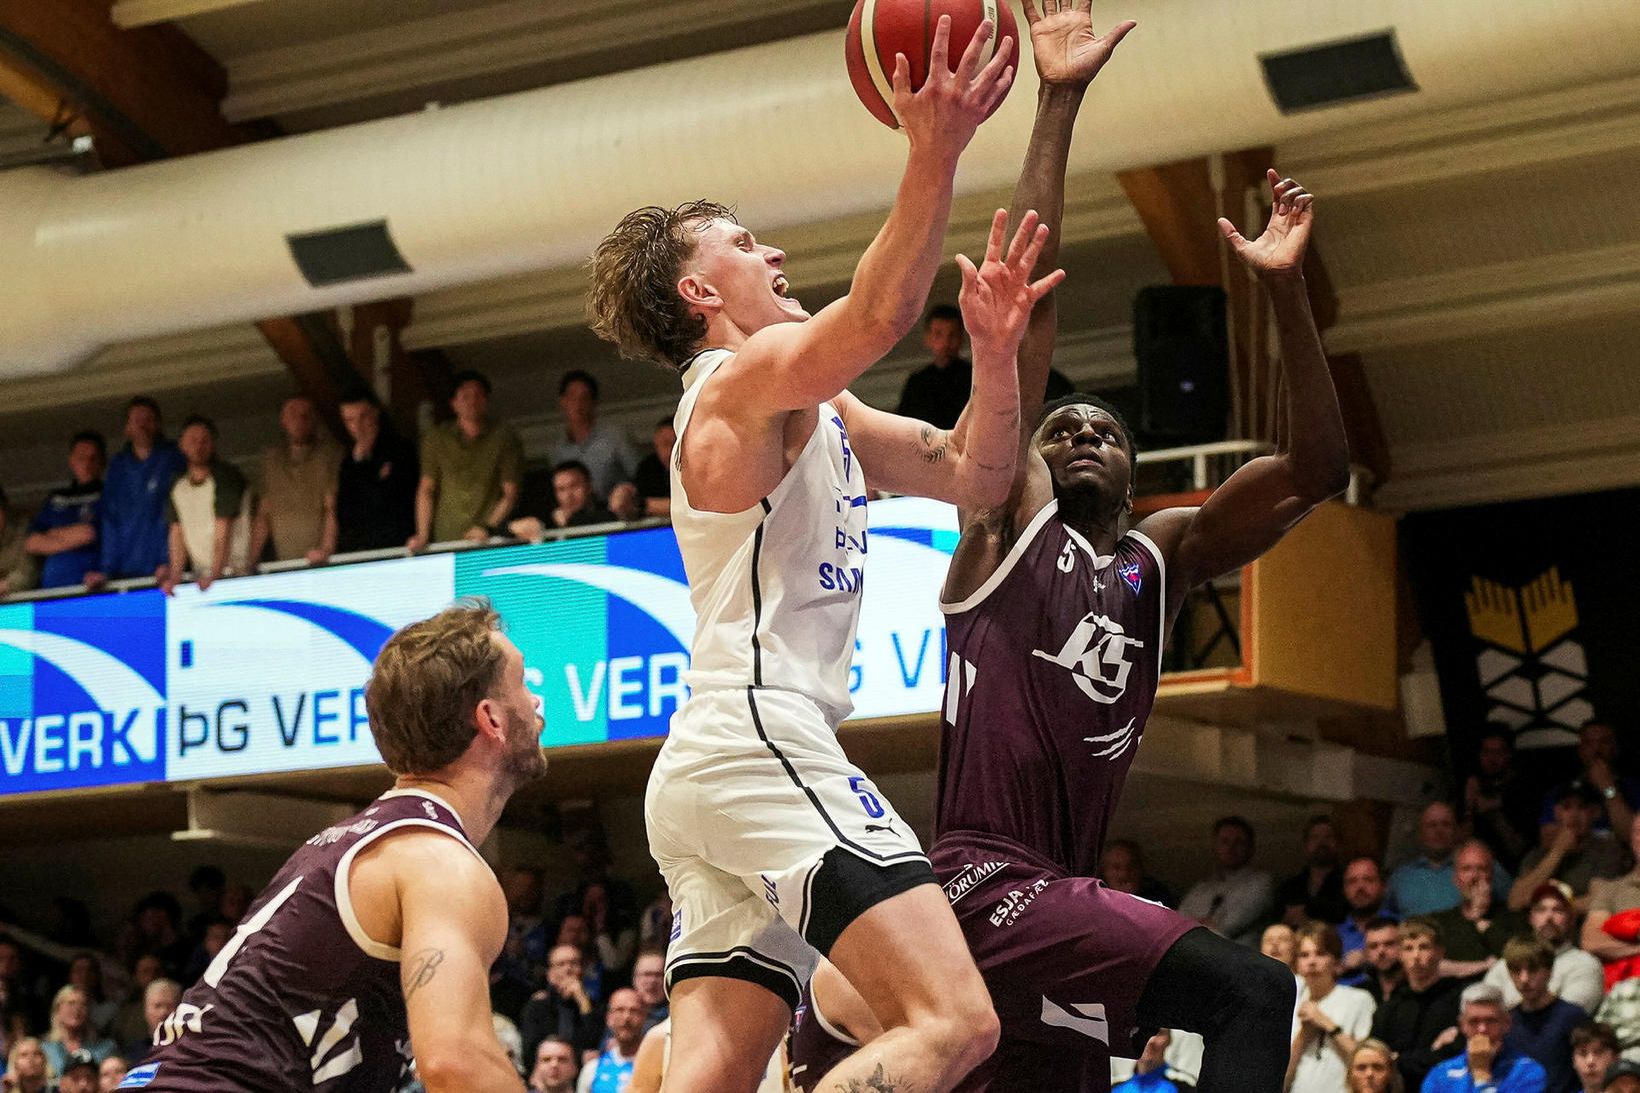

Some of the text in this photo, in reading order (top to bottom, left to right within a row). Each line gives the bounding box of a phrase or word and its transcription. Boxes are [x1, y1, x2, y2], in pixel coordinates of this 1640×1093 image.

[1057, 538, 1077, 574] 5
[848, 777, 885, 818] 5
[989, 890, 1025, 928] ESJA
